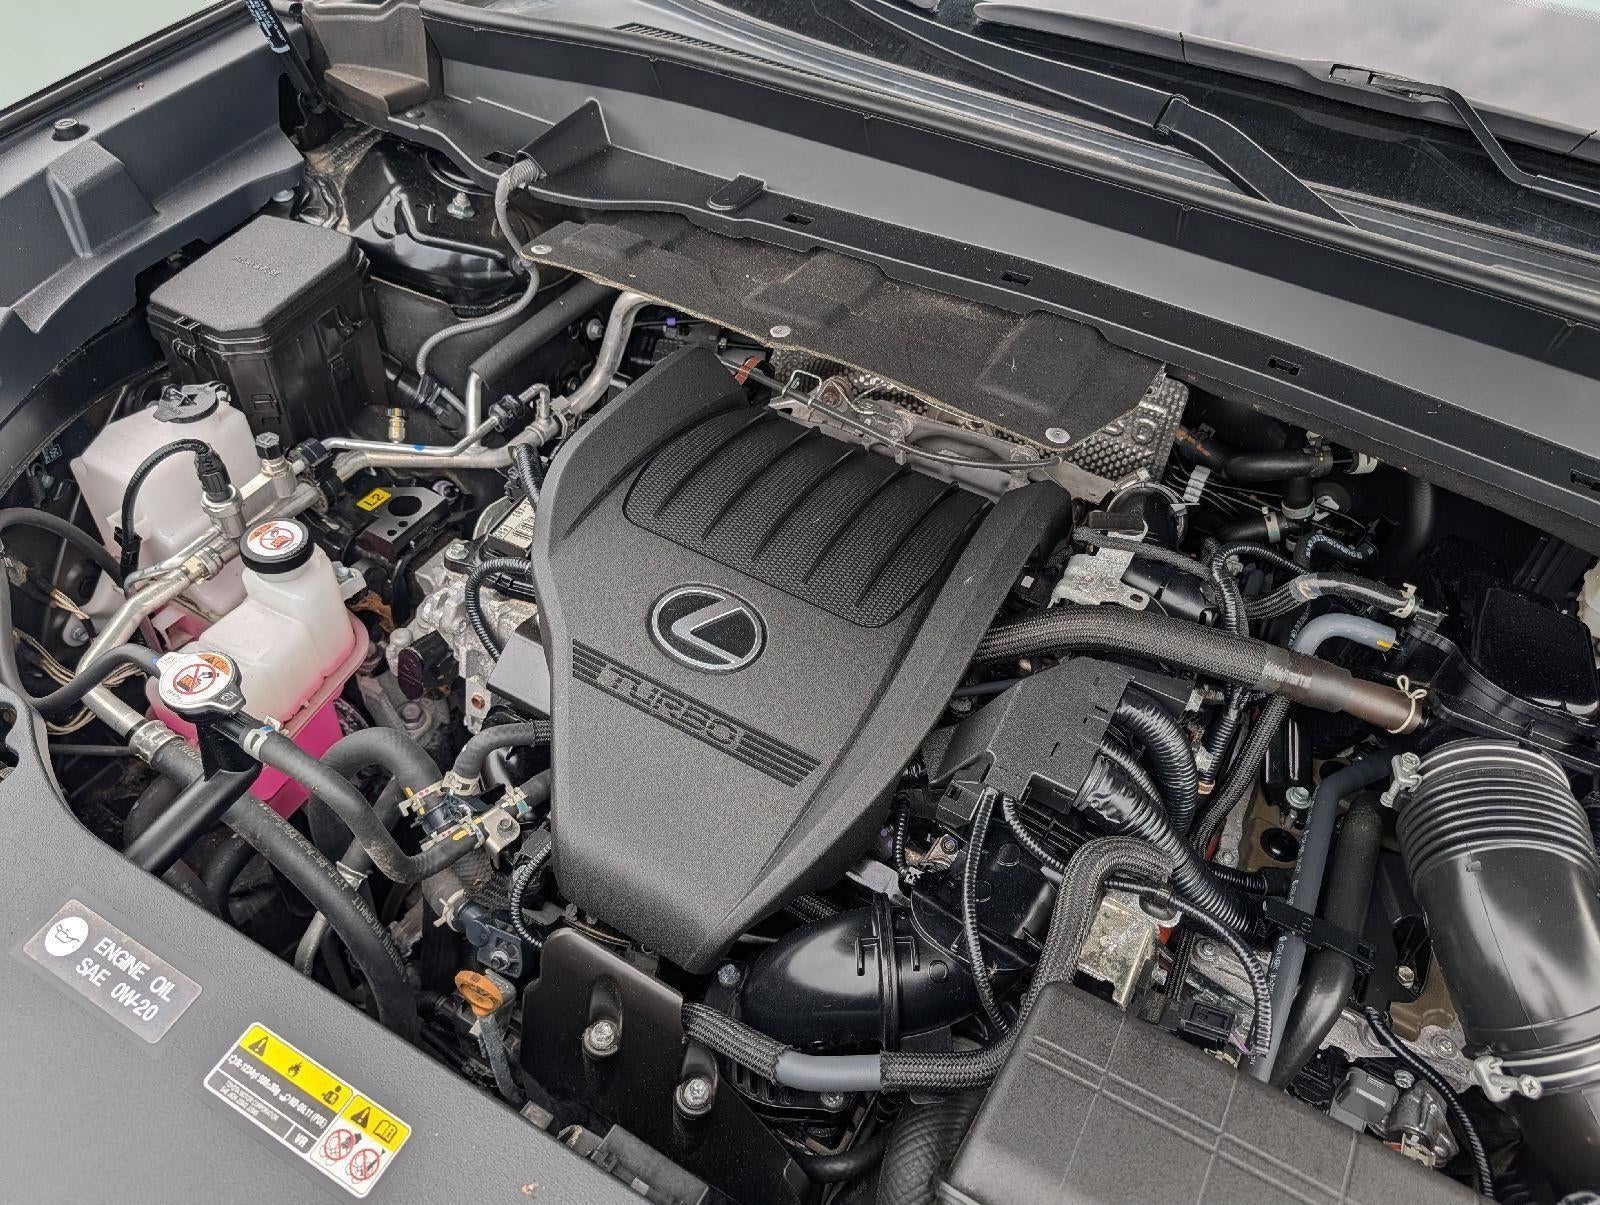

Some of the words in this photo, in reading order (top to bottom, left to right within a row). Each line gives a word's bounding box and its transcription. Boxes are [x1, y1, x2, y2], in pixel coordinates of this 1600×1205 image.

[363, 493, 385, 506] L2
[610, 666, 738, 745] TURBO
[76, 957, 112, 987] SAE
[110, 982, 159, 1021] 0W-20
[93, 937, 151, 981] ENGINE
[149, 975, 176, 1002] OIL
